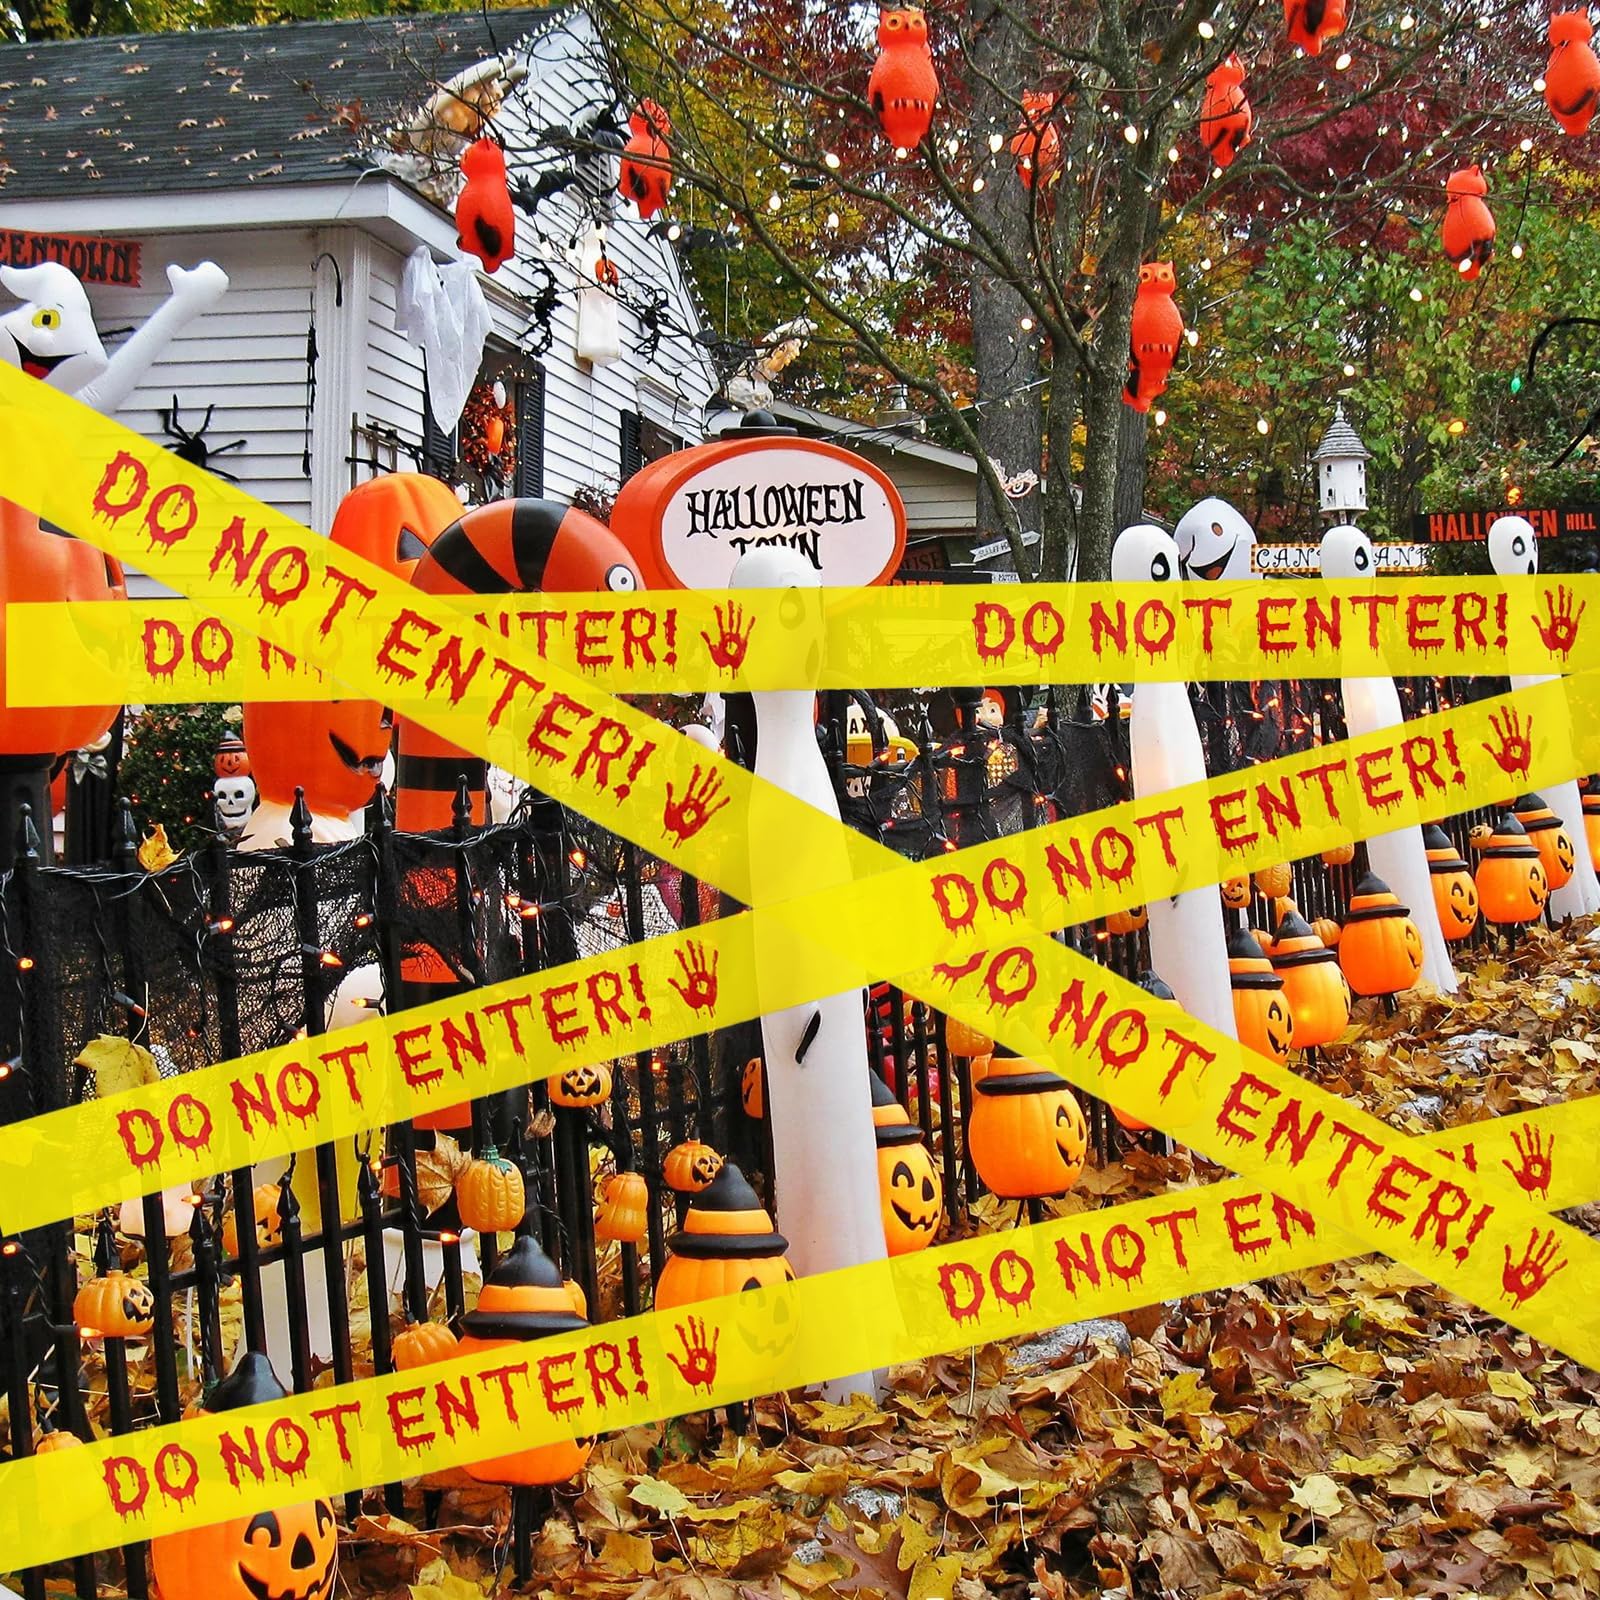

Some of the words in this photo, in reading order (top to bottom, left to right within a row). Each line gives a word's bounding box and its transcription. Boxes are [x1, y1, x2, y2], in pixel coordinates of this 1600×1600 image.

[685, 479, 866, 538] HALLOWEEN
[1566, 513, 1596, 530] HILL
[730, 529, 823, 570] TN
[1256, 547, 1321, 568] CAN
